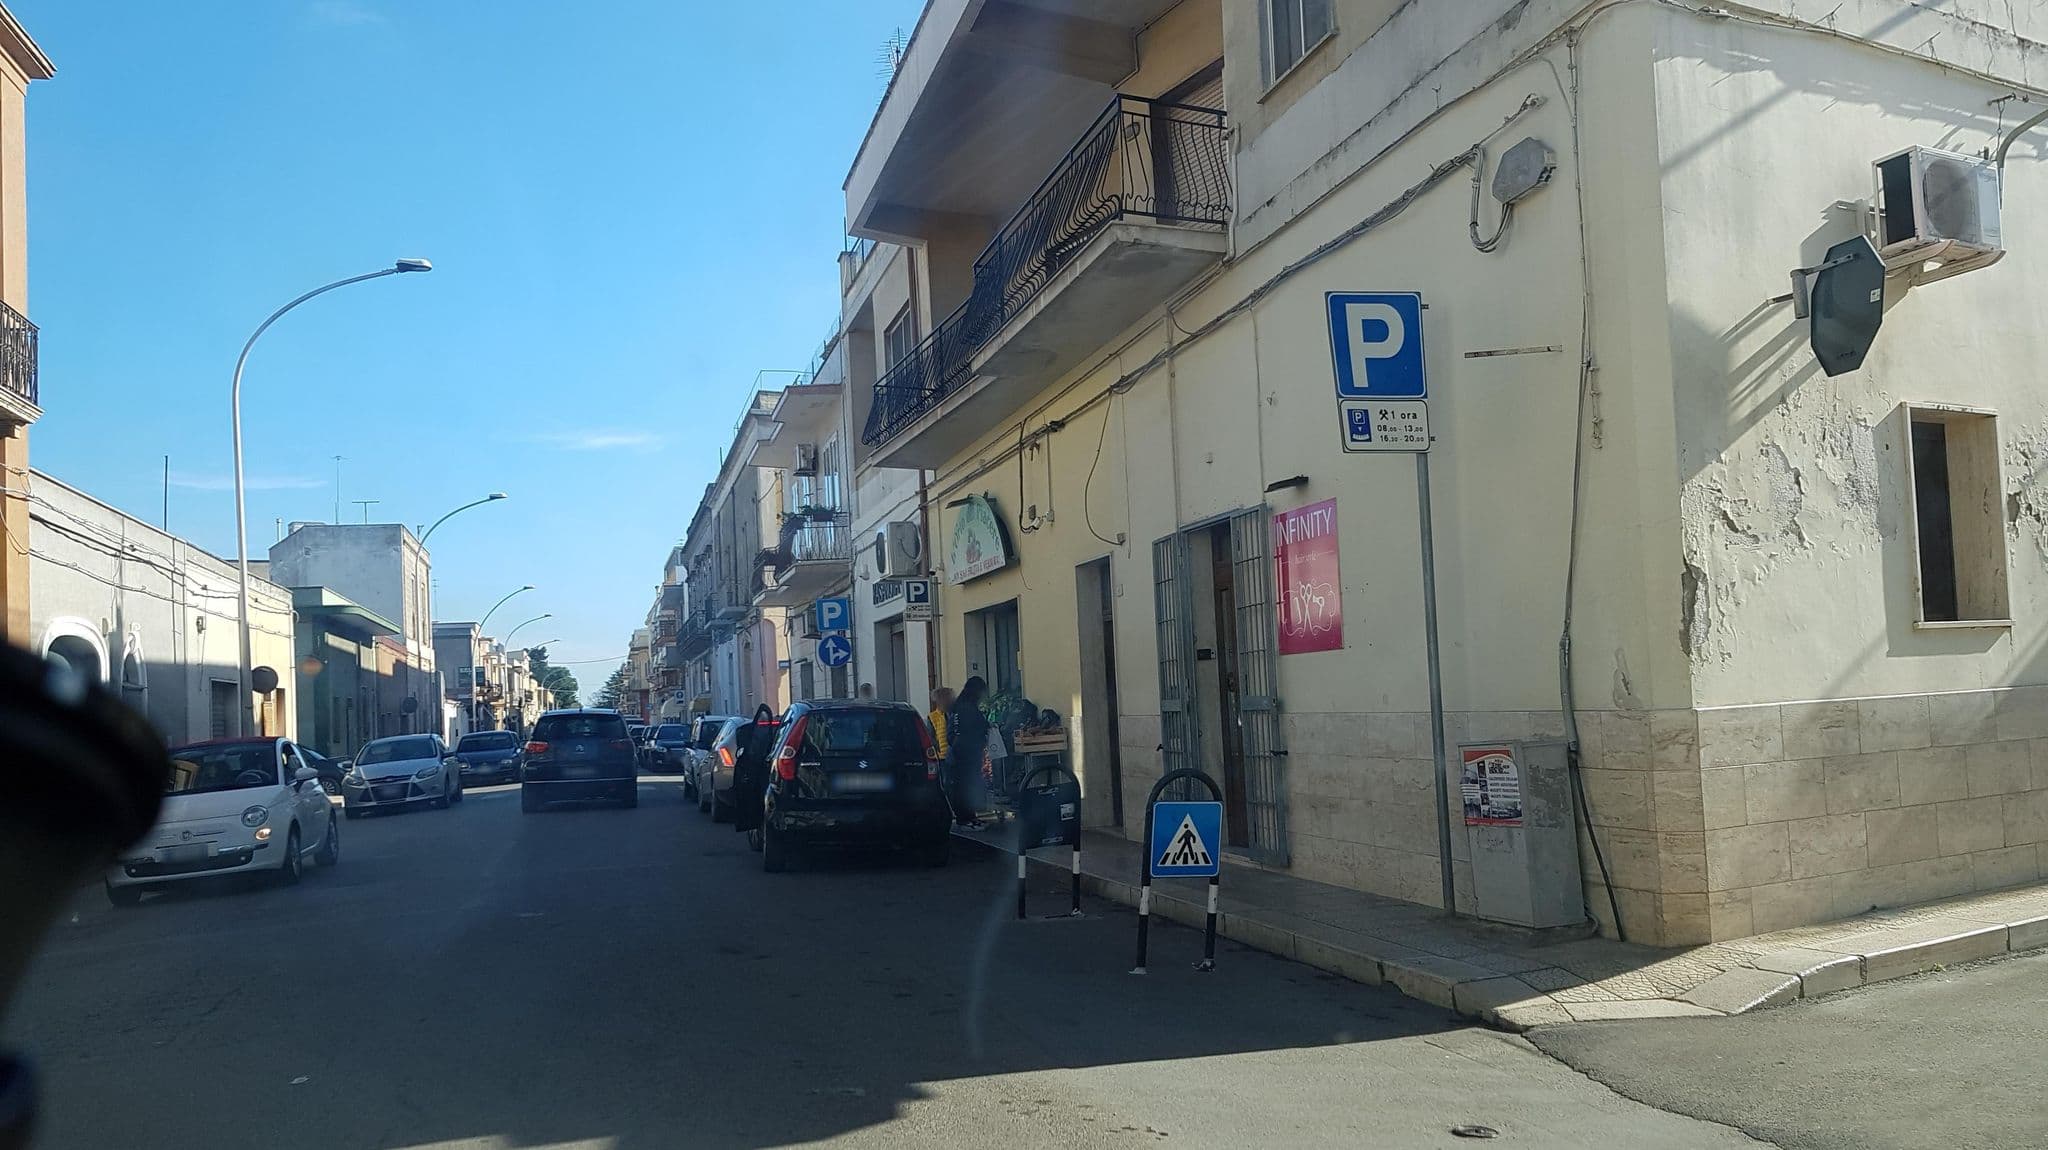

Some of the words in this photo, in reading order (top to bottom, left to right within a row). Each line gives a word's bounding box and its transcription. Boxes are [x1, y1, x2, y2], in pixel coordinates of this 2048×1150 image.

[1345, 303, 1405, 388] P
[1355, 412, 1362, 423] P
[1391, 410, 1396, 420] 1
[1400, 412, 1418, 420] ora
[1276, 508, 1332, 547] INFINITY
[909, 582, 925, 602] P
[822, 602, 842, 628] P
